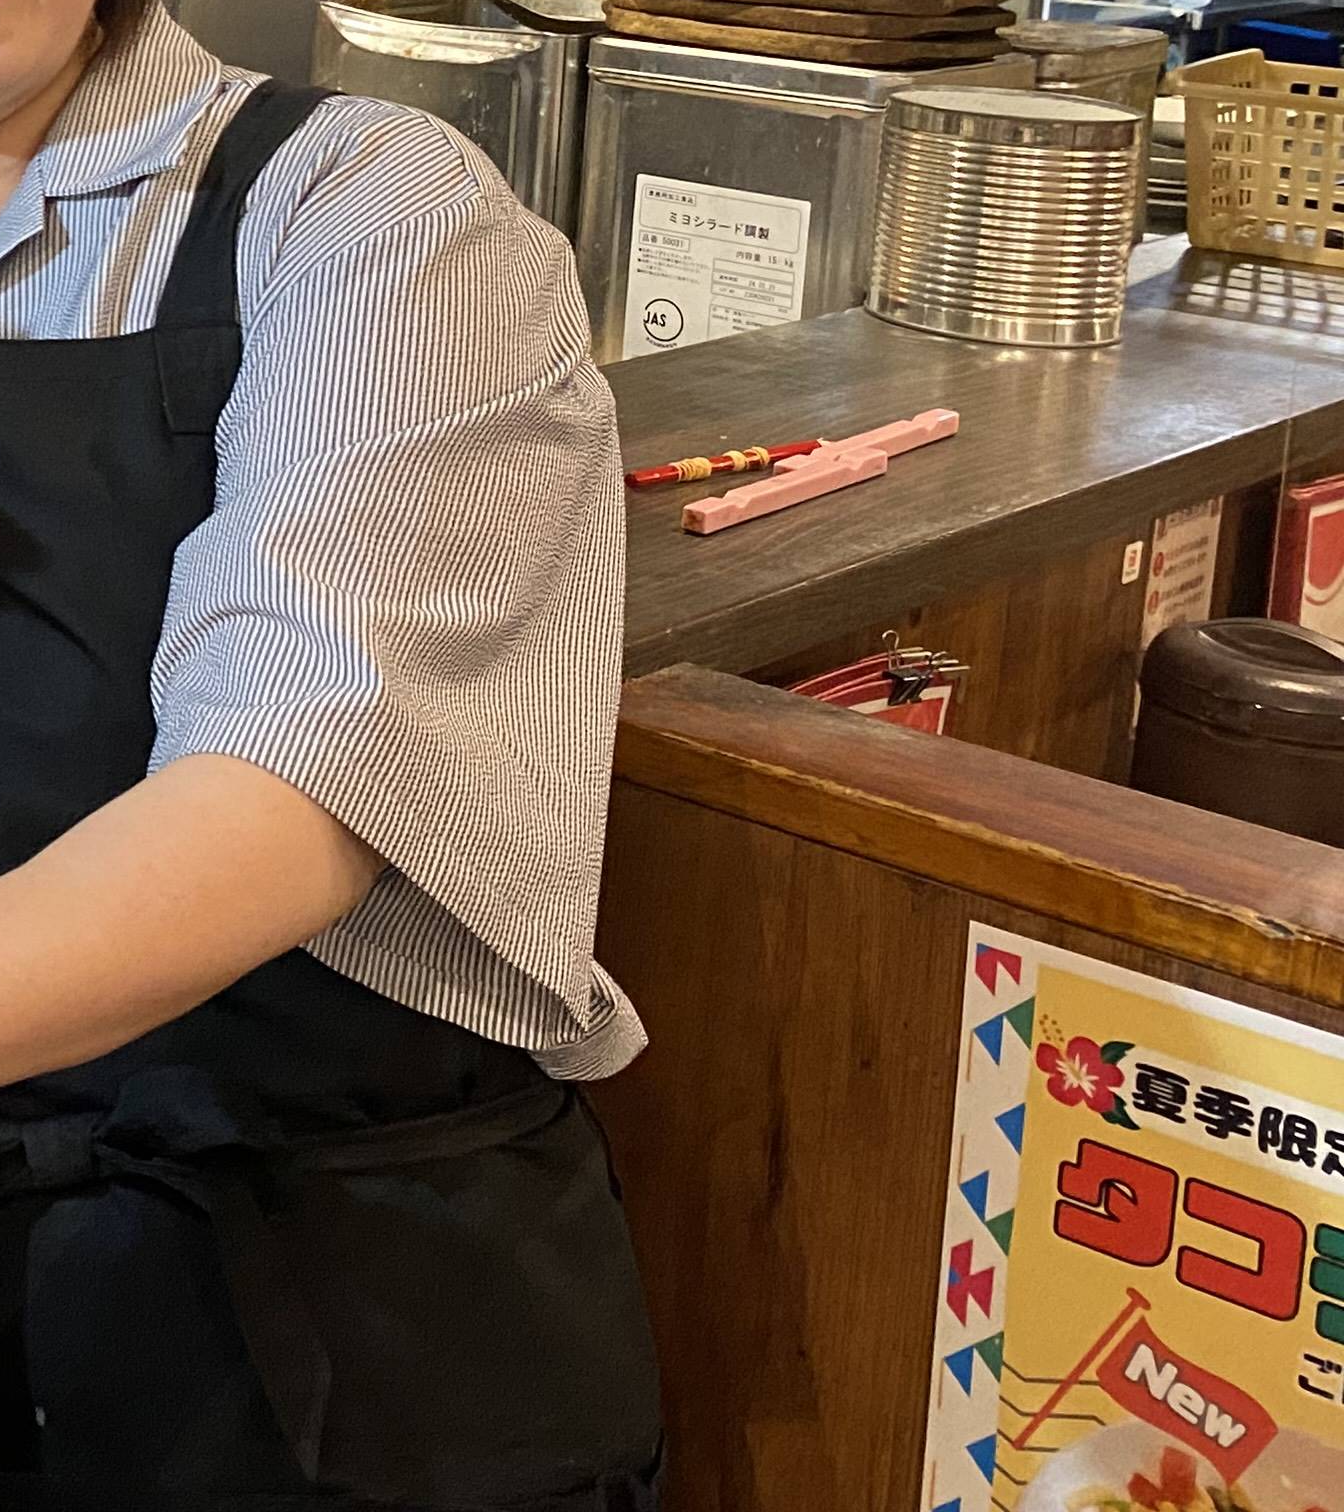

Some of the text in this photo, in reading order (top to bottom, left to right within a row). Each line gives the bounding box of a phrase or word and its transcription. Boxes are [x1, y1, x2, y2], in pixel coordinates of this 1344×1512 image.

[642, 233, 658, 243] 品番
[669, 212, 770, 240] ミヨシラード調製
[736, 251, 761, 262] 内容量
[643, 311, 667, 327] JAS
[1054, 1138, 1344, 1345] タコ
[1299, 1354, 1344, 1401] ご
[1125, 1344, 1246, 1448] New
